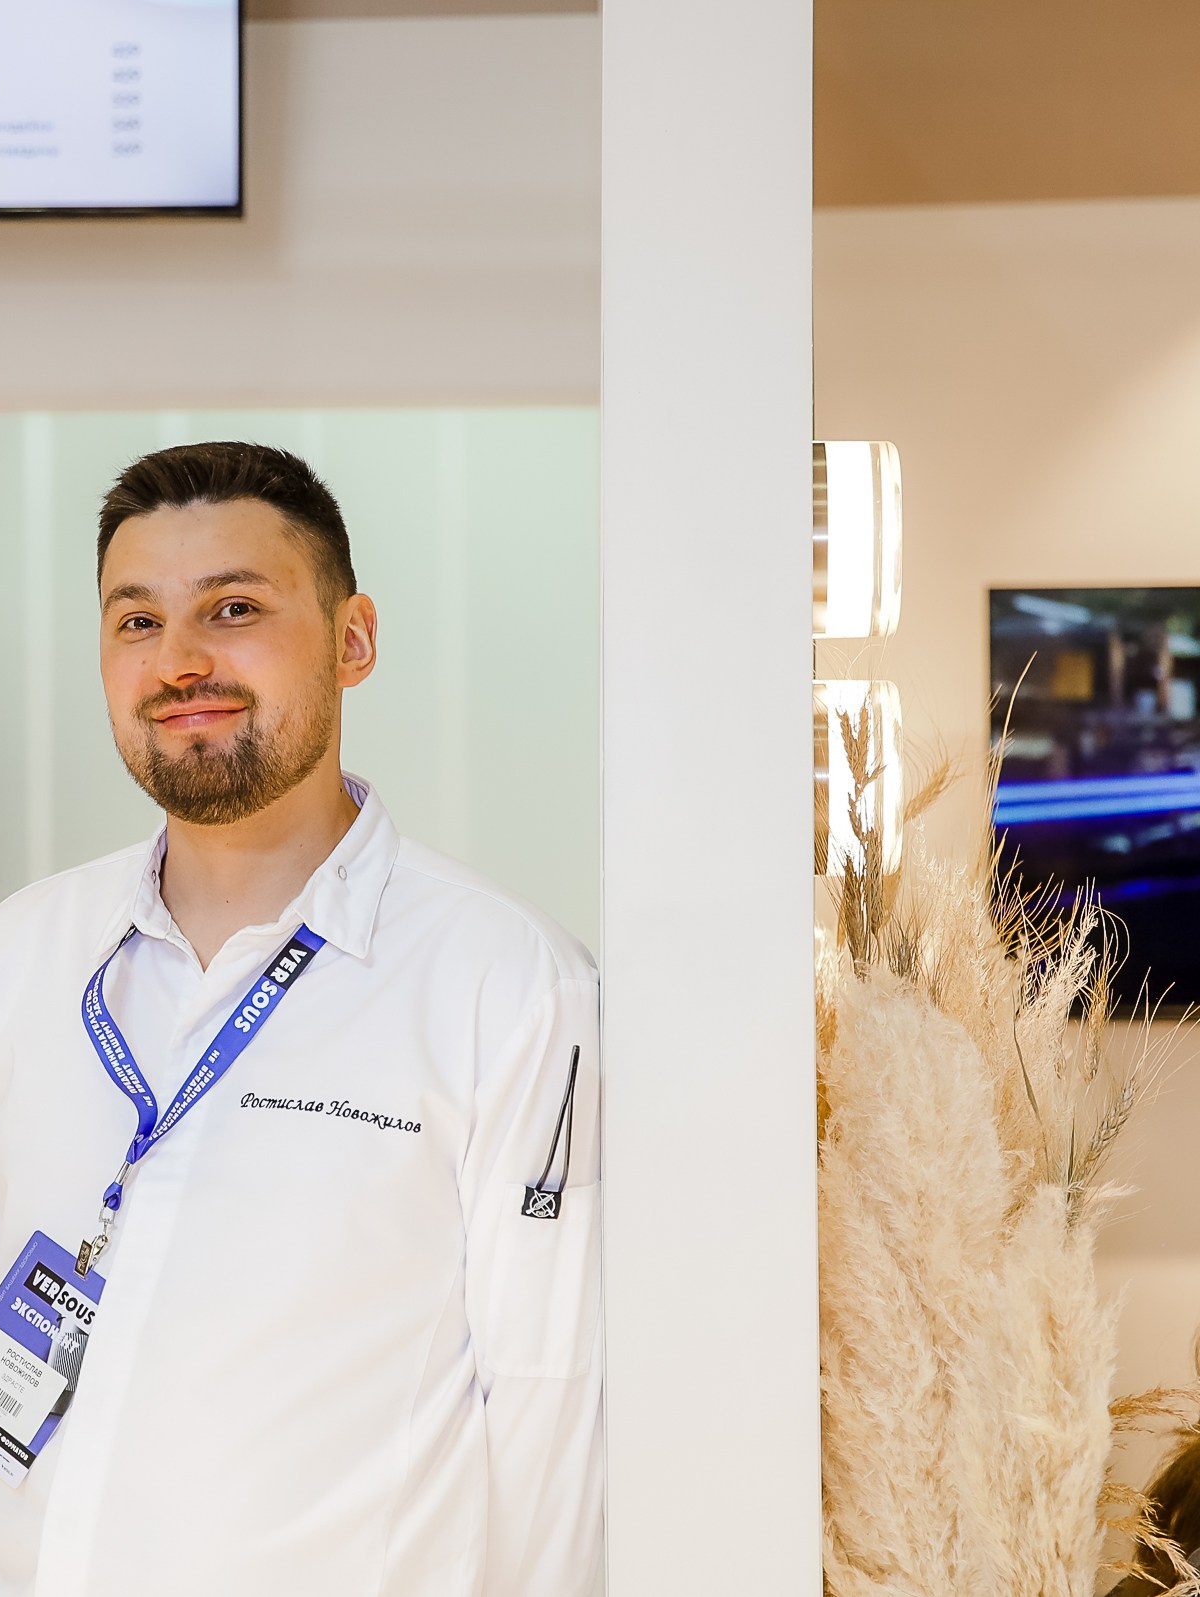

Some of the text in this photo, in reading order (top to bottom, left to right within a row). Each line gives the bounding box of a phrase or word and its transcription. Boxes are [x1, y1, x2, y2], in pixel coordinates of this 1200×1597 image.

[86, 988, 138, 1096] ПРЕДПРИНИМАТЕЛЬСТВО
[99, 1020, 127, 1060] ВАШЕМУ
[207, 1049, 221, 1064] НЕ
[122, 1063, 147, 1094] ВРЕДИТ
[181, 1064, 209, 1100] ВРЕДИТ
[143, 1095, 154, 1108] НЕ
[240, 1092, 422, 1134] Ростислав Новожилов
[31, 1268, 96, 1326] VERSOUS
[10, 1296, 81, 1354] ЭКСПОННТ
[0, 1355, 40, 1389] НОВОЖИЛОВ
[6, 1347, 43, 1379] РОСТИСЛАВ
